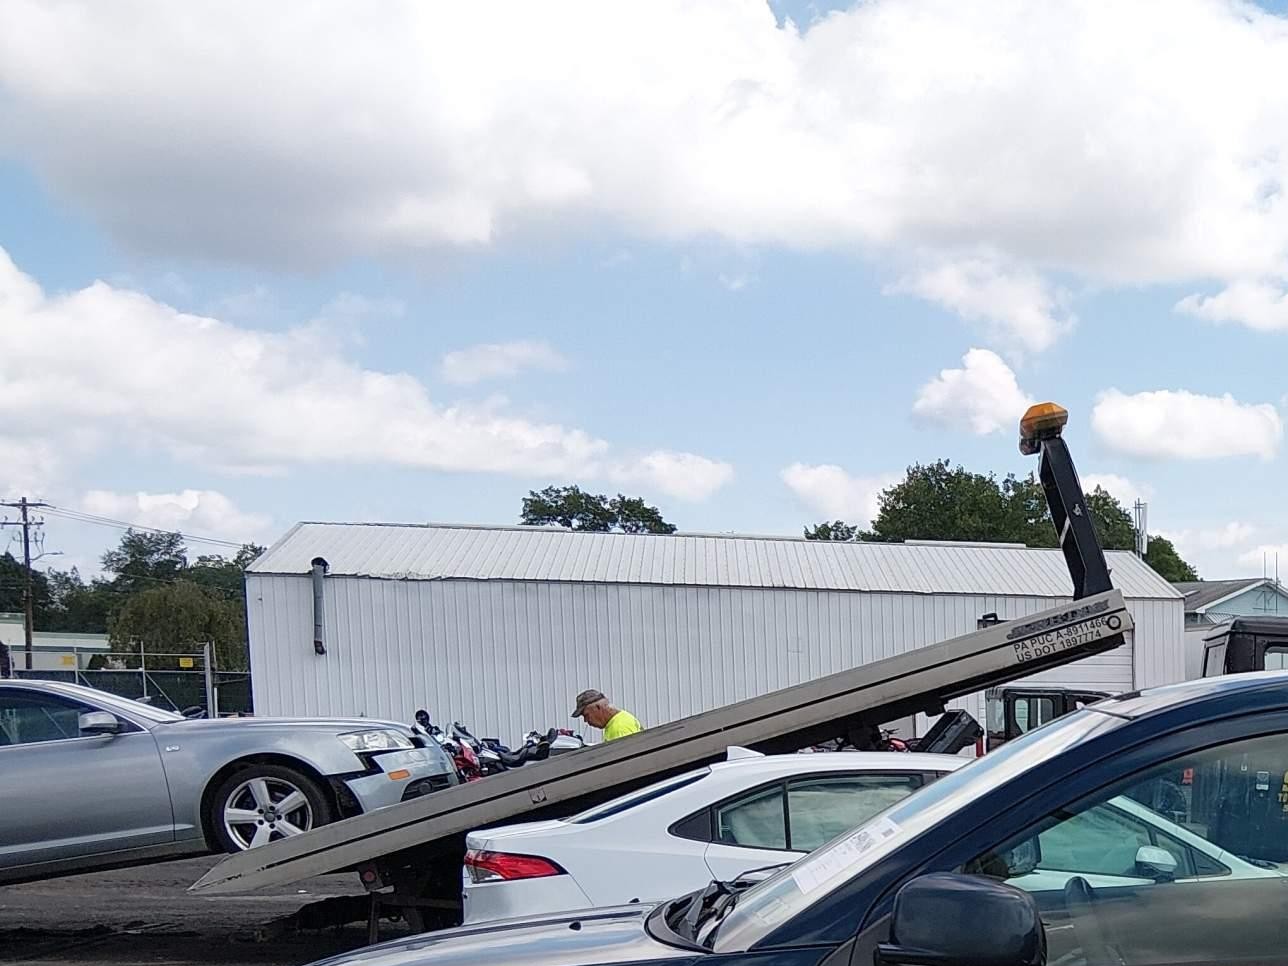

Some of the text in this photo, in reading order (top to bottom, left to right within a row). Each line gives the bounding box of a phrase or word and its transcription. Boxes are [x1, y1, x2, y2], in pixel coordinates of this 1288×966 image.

[1013, 643, 1029, 653] PA
[1030, 634, 1053, 648] PUC
[1016, 629, 1101, 663] US DOT 1897774
